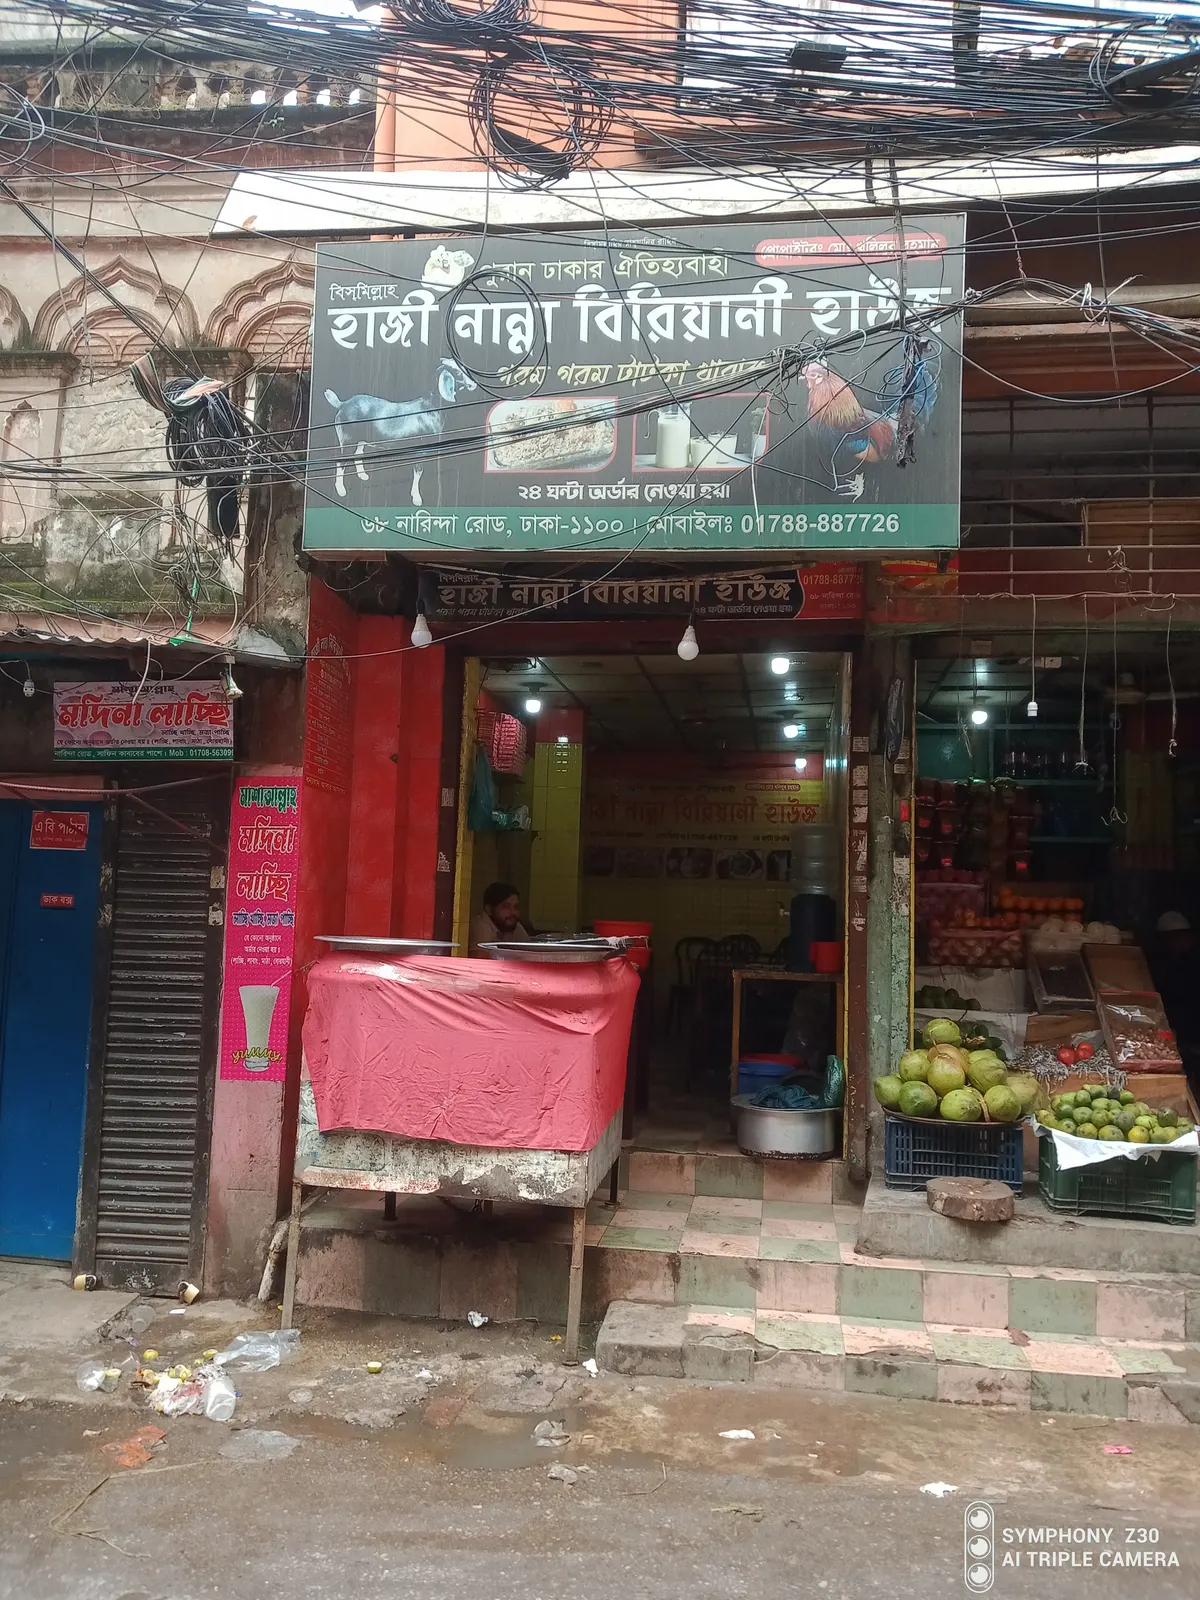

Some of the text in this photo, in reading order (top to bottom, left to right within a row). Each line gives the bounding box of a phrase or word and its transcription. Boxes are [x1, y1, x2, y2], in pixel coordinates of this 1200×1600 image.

[540, 258, 605, 283] ঢাকার
[613, 248, 730, 279] ঐতিহ্যবাহী
[328, 289, 440, 349] হাজী
[453, 299, 561, 357] নান্না
[573, 276, 793, 345] বিরিয়ানী
[498, 364, 550, 385] গরম
[557, 362, 613, 386] গরম
[617, 354, 691, 386] টাটকা
[518, 485, 542, 500] ২৪
[546, 480, 584, 500] ঘন্টা
[588, 478, 641, 500] অর্ডার
[644, 483, 695, 502] নেওয়া
[360, 516, 390, 534] ৬৮
[395, 509, 459, 535] নারিন্দা
[465, 515, 513, 538] রোড,
[519, 513, 624, 535] ঢাকা-১১০০
[741, 513, 900, 534] 01788-887726
[438, 577, 503, 606] হাজী
[510, 583, 573, 610] নান্না
[713, 574, 796, 601] হাউজ
[58, 691, 233, 729] মদিনা লাচ্ছি
[168, 749, 184, 757] Mob
[190, 748, 233, 757] 01708-56309
[764, 796, 819, 824] হাউজ
[238, 815, 297, 855] মদিনা
[236, 861, 292, 902] লাচ্ছি
[43, 895, 58, 904] ডাক
